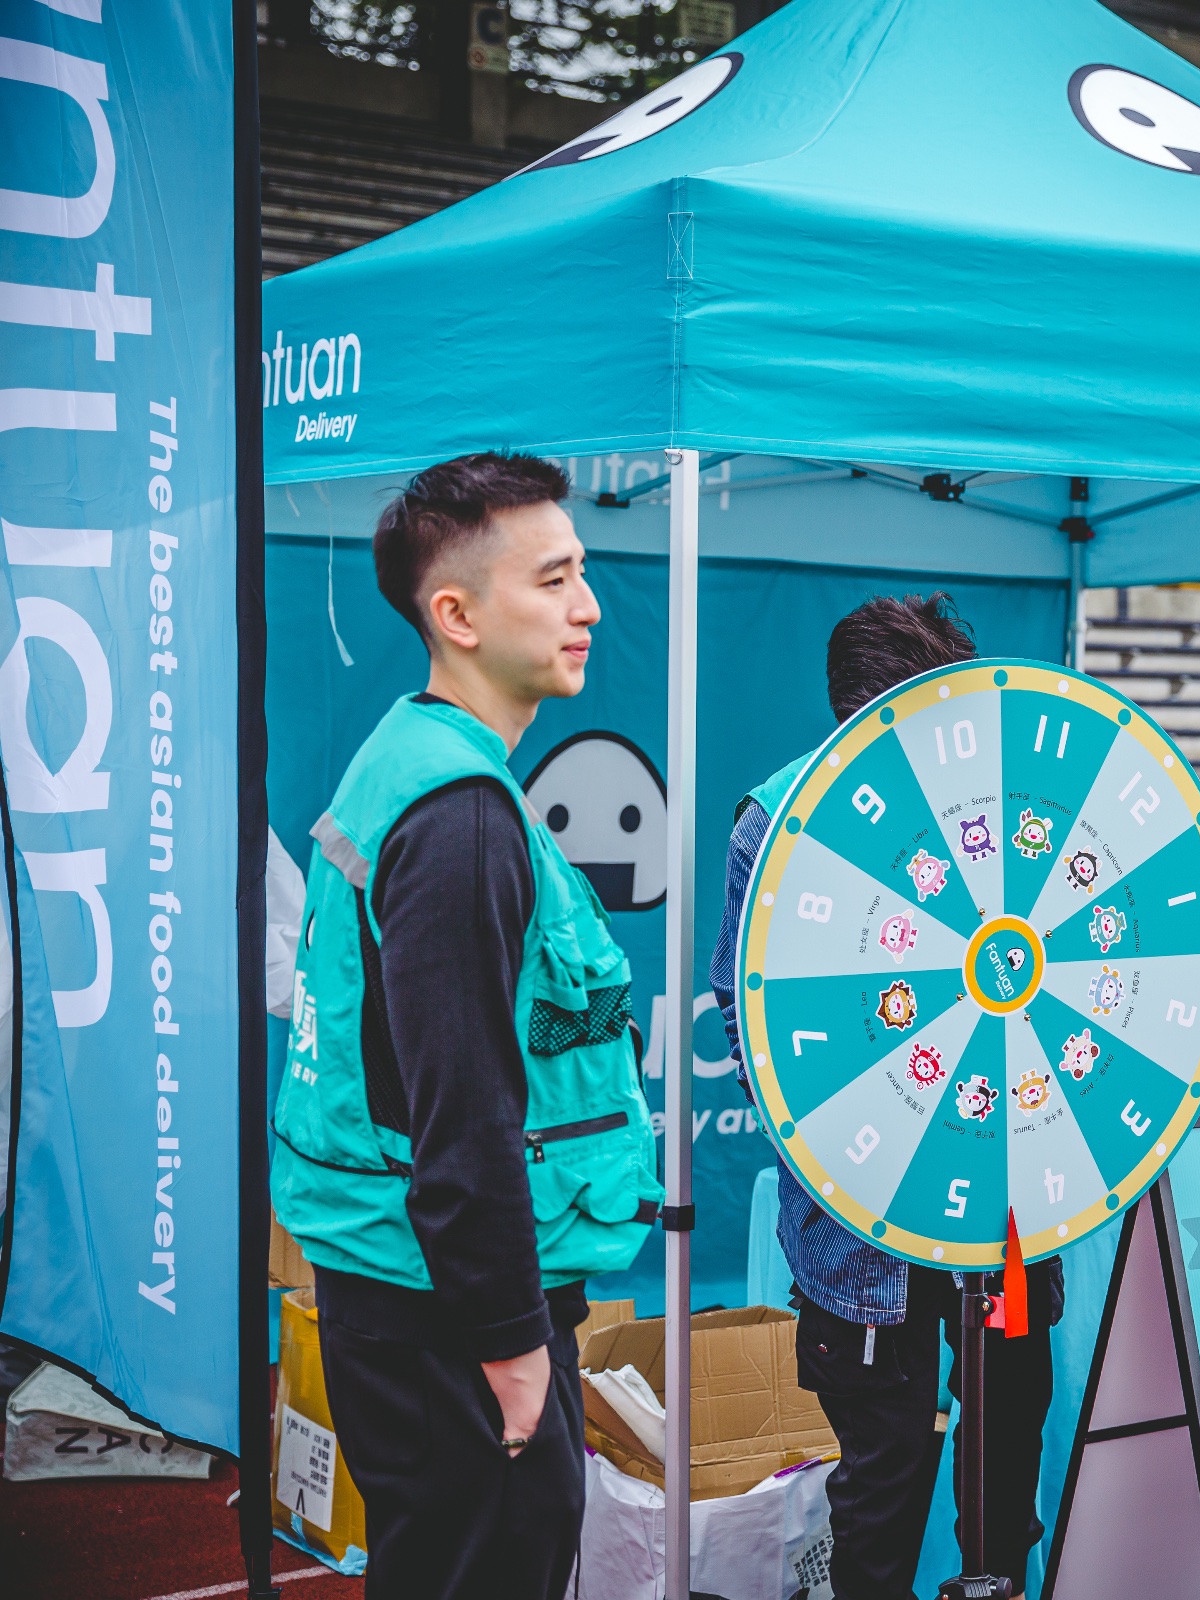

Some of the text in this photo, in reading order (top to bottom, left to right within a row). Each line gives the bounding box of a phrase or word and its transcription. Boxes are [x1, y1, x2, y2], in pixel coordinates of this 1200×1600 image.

[295, 411, 358, 442] Delivery
[0, 0, 151, 1028] ntuan
[934, 719, 978, 765] 10
[1032, 714, 1071, 759] 11
[851, 783, 886, 824] 9
[971, 795, 997, 806] Scorpio
[1039, 796, 1072, 816] Sagittarius
[1117, 771, 1161, 826] 12
[912, 828, 929, 843] Libra
[138, 397, 182, 1315] The best asian food delivery
[1102, 843, 1123, 876] Capricorn
[797, 891, 833, 924] 8
[867, 895, 881, 916] Virgo
[1168, 892, 1196, 907] 1
[1132, 919, 1140, 953] Aquarius
[985, 942, 1015, 997] Fantuan
[860, 991, 868, 1007] Leo
[1165, 999, 1198, 1028] 2
[1122, 1007, 1135, 1029] Pisces
[792, 1030, 828, 1056] 7
[886, 1071, 904, 1096] Cancer
[1079, 1082, 1095, 1097] Aries
[943, 1120, 966, 1135] Gemini
[1013, 1124, 1036, 1135] Taurus
[1120, 1100, 1153, 1137] 3
[844, 1122, 881, 1165] 6
[943, 1177, 971, 1219] 5
[1043, 1167, 1065, 1203] 4
